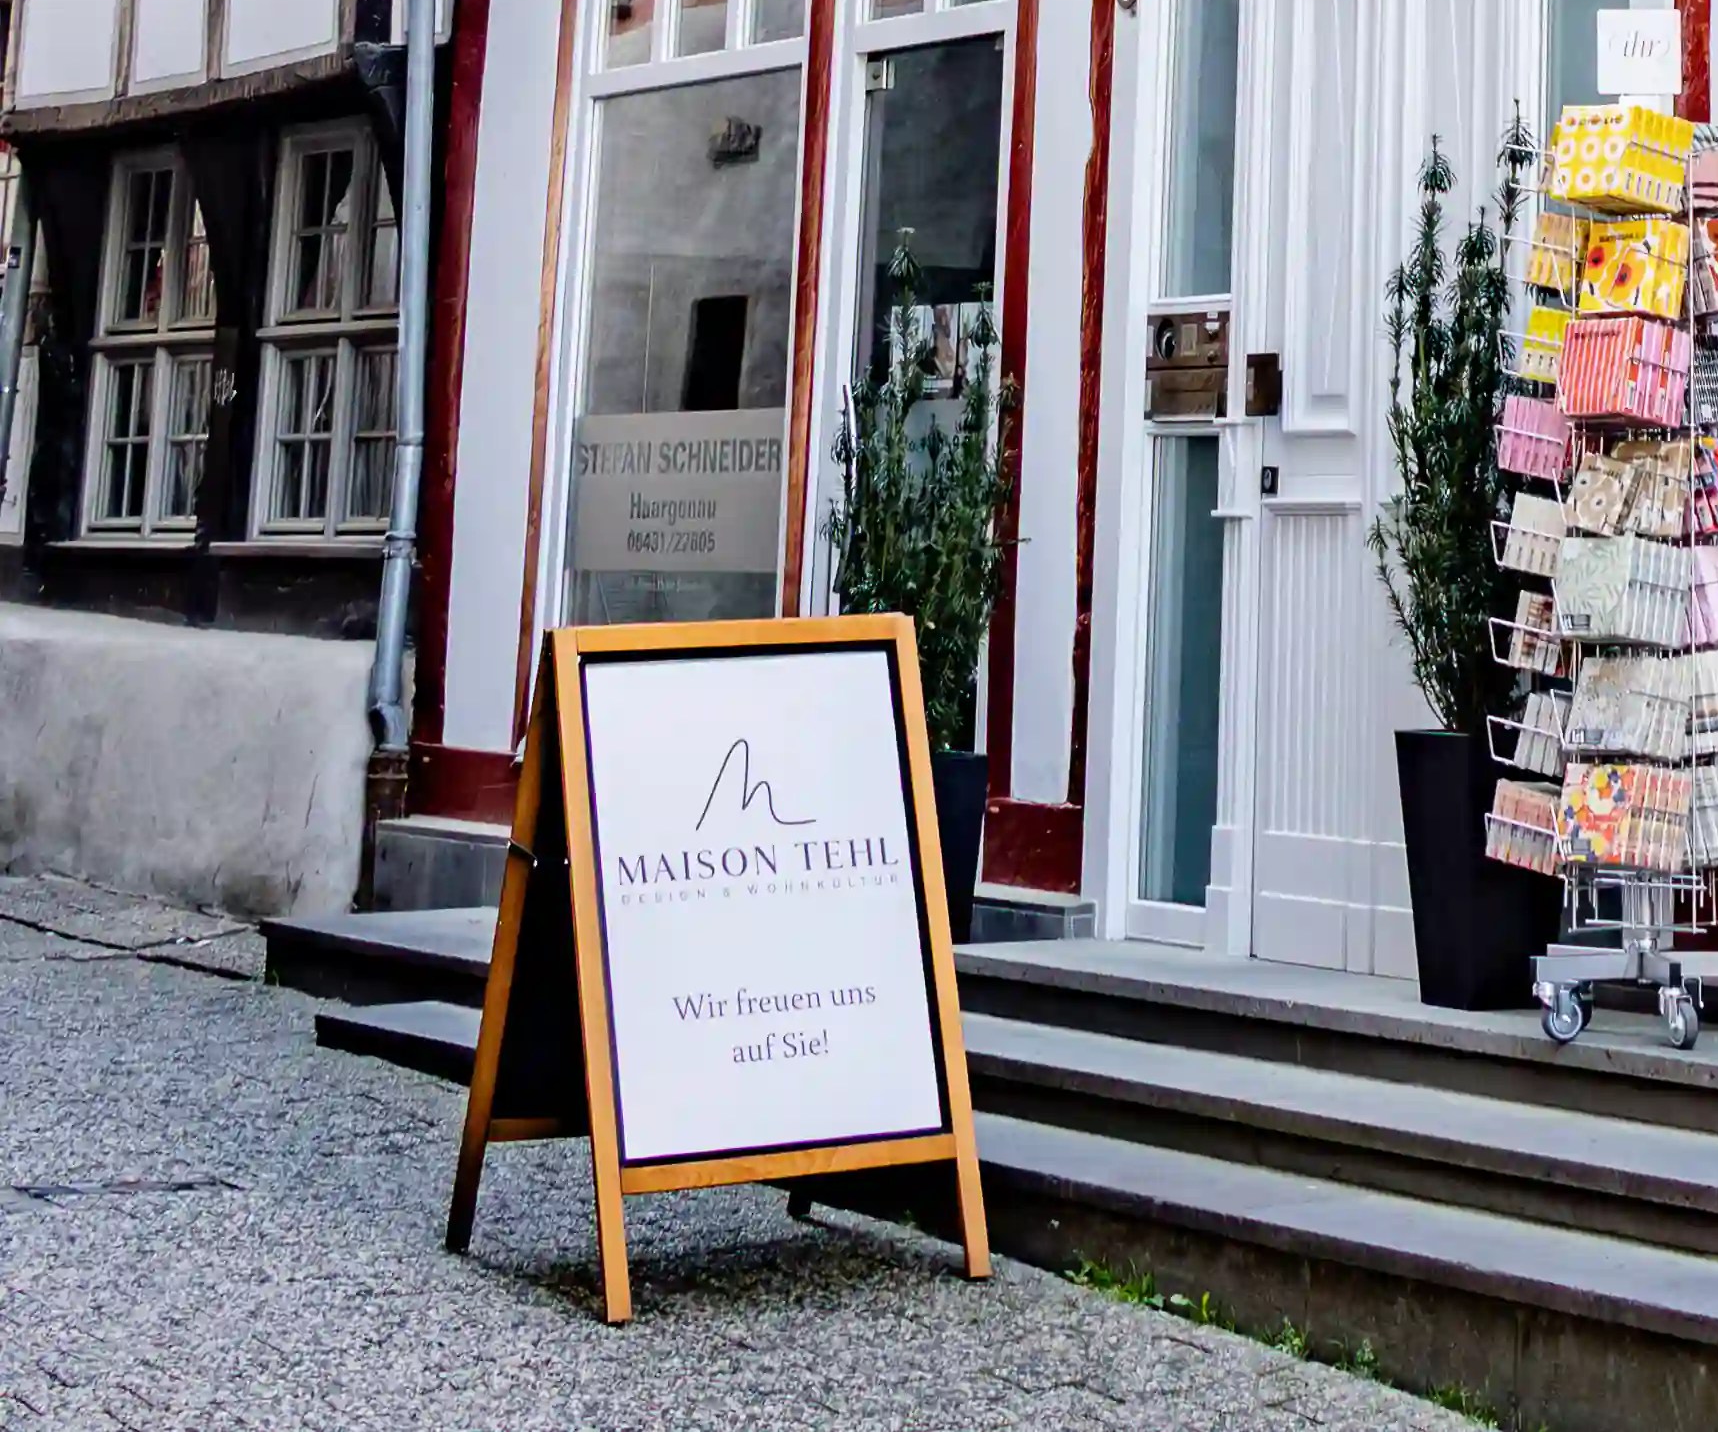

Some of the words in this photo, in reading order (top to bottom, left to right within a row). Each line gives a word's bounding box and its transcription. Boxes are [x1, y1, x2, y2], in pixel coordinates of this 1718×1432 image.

[577, 440, 652, 476] STEFAN
[658, 436, 782, 475] SCHNEIDER
[618, 843, 778, 886] MAISON
[794, 837, 899, 871] TEHL
[621, 887, 707, 905] DESIGN
[748, 874, 898, 895] WOHNKULTUR
[672, 993, 728, 1021] Wir
[736, 988, 822, 1015] freuen
[830, 985, 877, 1006] uns
[732, 1033, 775, 1064] auf
[782, 1029, 829, 1059] Sie!
